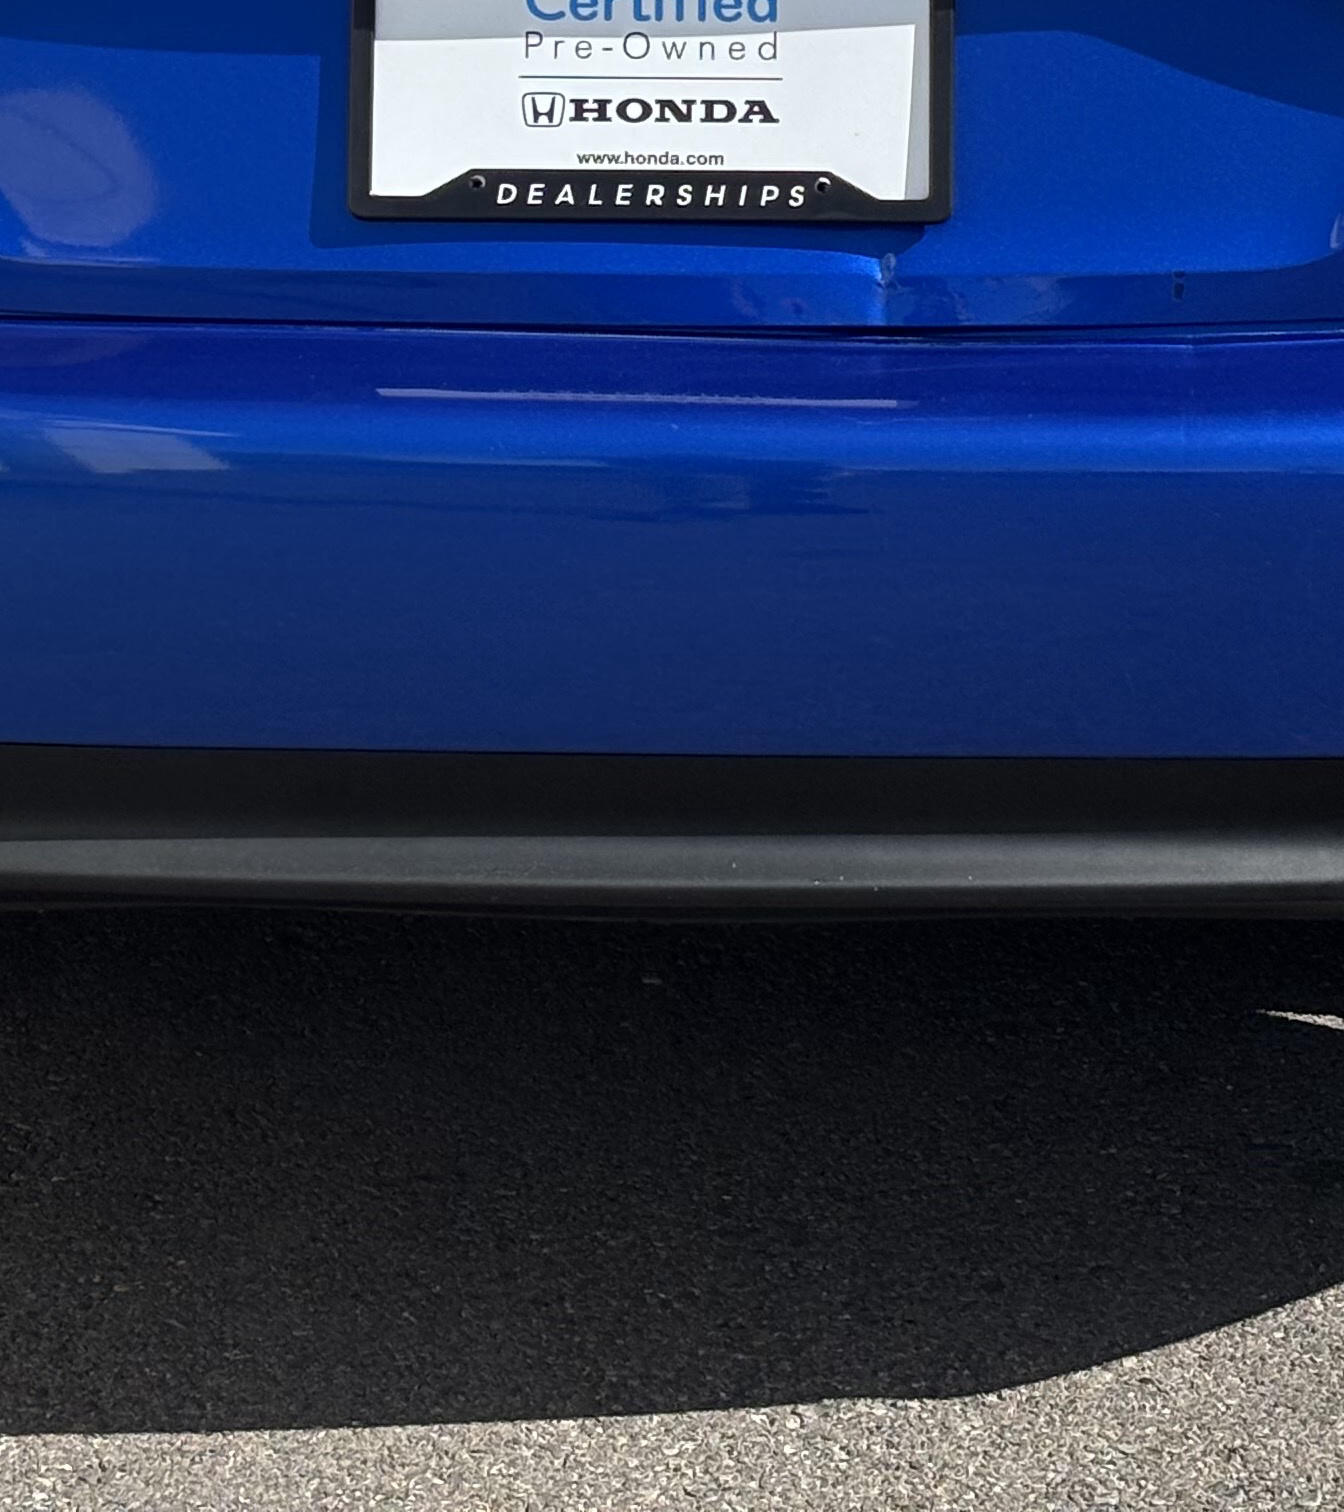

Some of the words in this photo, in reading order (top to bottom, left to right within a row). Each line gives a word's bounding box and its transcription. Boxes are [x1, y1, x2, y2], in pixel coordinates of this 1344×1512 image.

[524, 31, 778, 61] Pre-Owned
[568, 98, 779, 125] HONDA
[576, 151, 724, 167] www.honda.com
[496, 182, 805, 208] DEALERSHIPS
